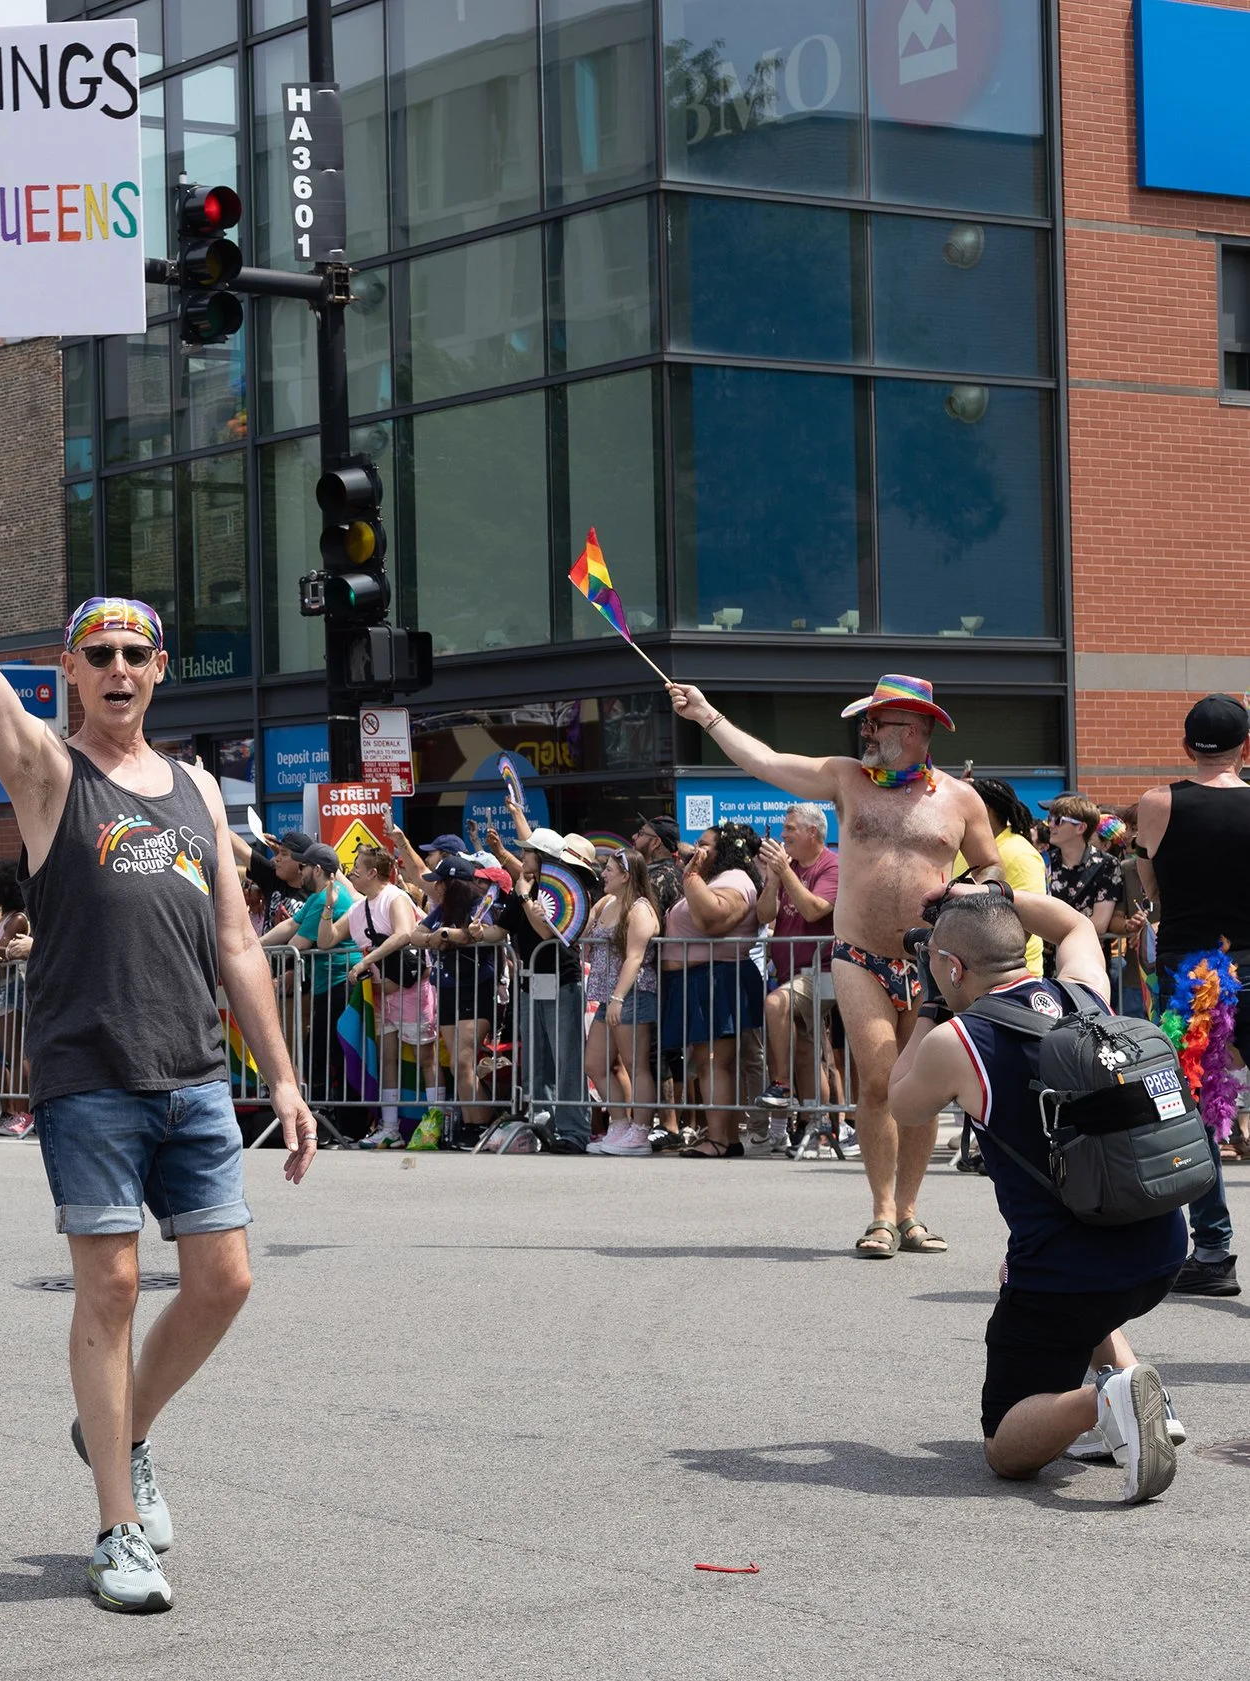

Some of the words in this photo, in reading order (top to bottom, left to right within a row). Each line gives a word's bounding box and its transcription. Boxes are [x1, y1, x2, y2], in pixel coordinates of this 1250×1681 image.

[286, 87, 314, 258] HA3601
[181, 651, 235, 679] Halsted
[16, 688, 34, 699] MO
[277, 749, 310, 767] Deposit
[311, 748, 330, 763] rain
[277, 770, 307, 787] Change
[329, 788, 381, 801] STREET
[492, 806, 497, 815] a
[719, 801, 736, 811] Scan
[738, 803, 745, 811] or
[747, 801, 761, 811] visit
[501, 822, 506, 830] a
[729, 813, 753, 825] upload
[754, 816, 767, 826] any
[142, 829, 178, 855] FORTY
[120, 842, 173, 866] YEARS
[113, 857, 164, 875] PROUD
[1145, 1070, 1180, 1096] PRESS
